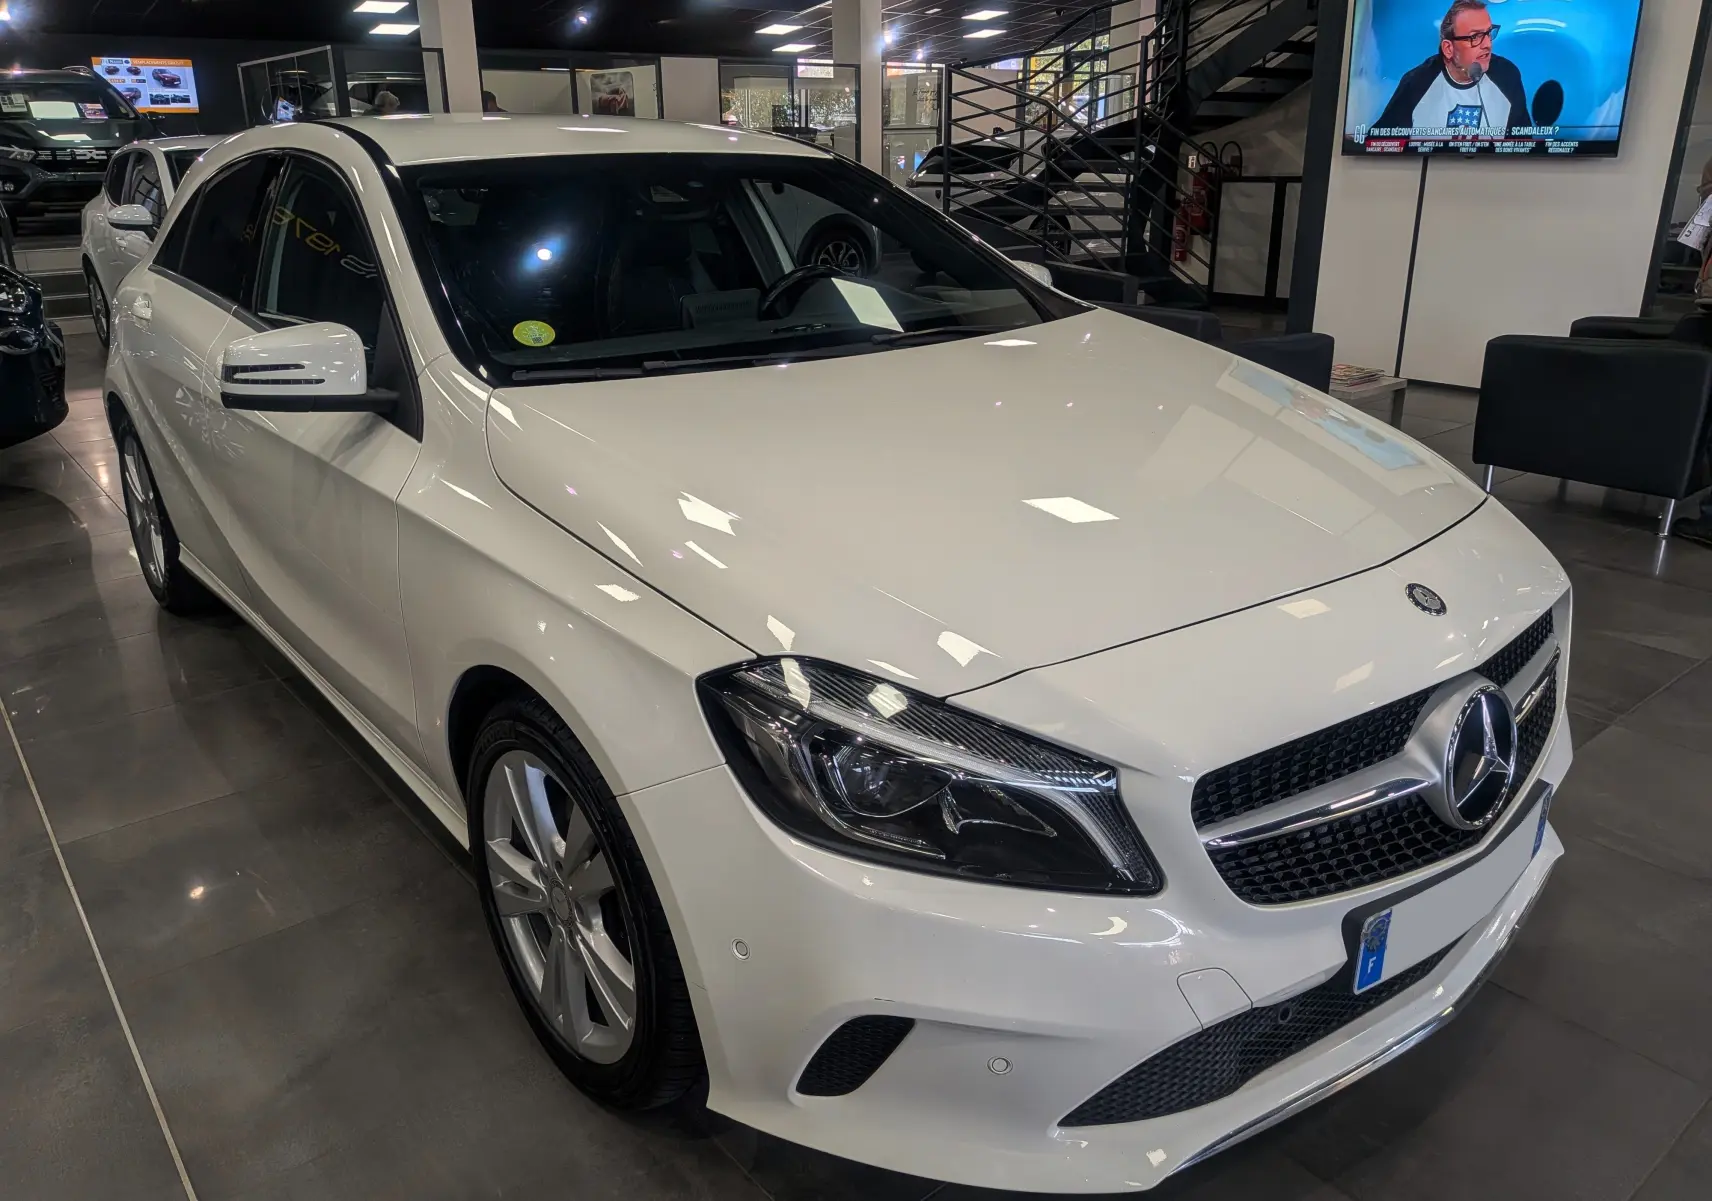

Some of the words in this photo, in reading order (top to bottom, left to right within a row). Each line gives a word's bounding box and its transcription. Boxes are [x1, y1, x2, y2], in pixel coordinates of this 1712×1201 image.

[1370, 127, 1379, 136] FIN
[1380, 127, 1390, 136] DES
[1391, 126, 1427, 136] DÉCOUVERTS
[1427, 127, 1459, 136] BANCAIRES
[1460, 127, 1505, 136] AUTOMATIQUES
[1511, 126, 1553, 136] SCANDALEUX
[1367, 956, 1377, 975] F
